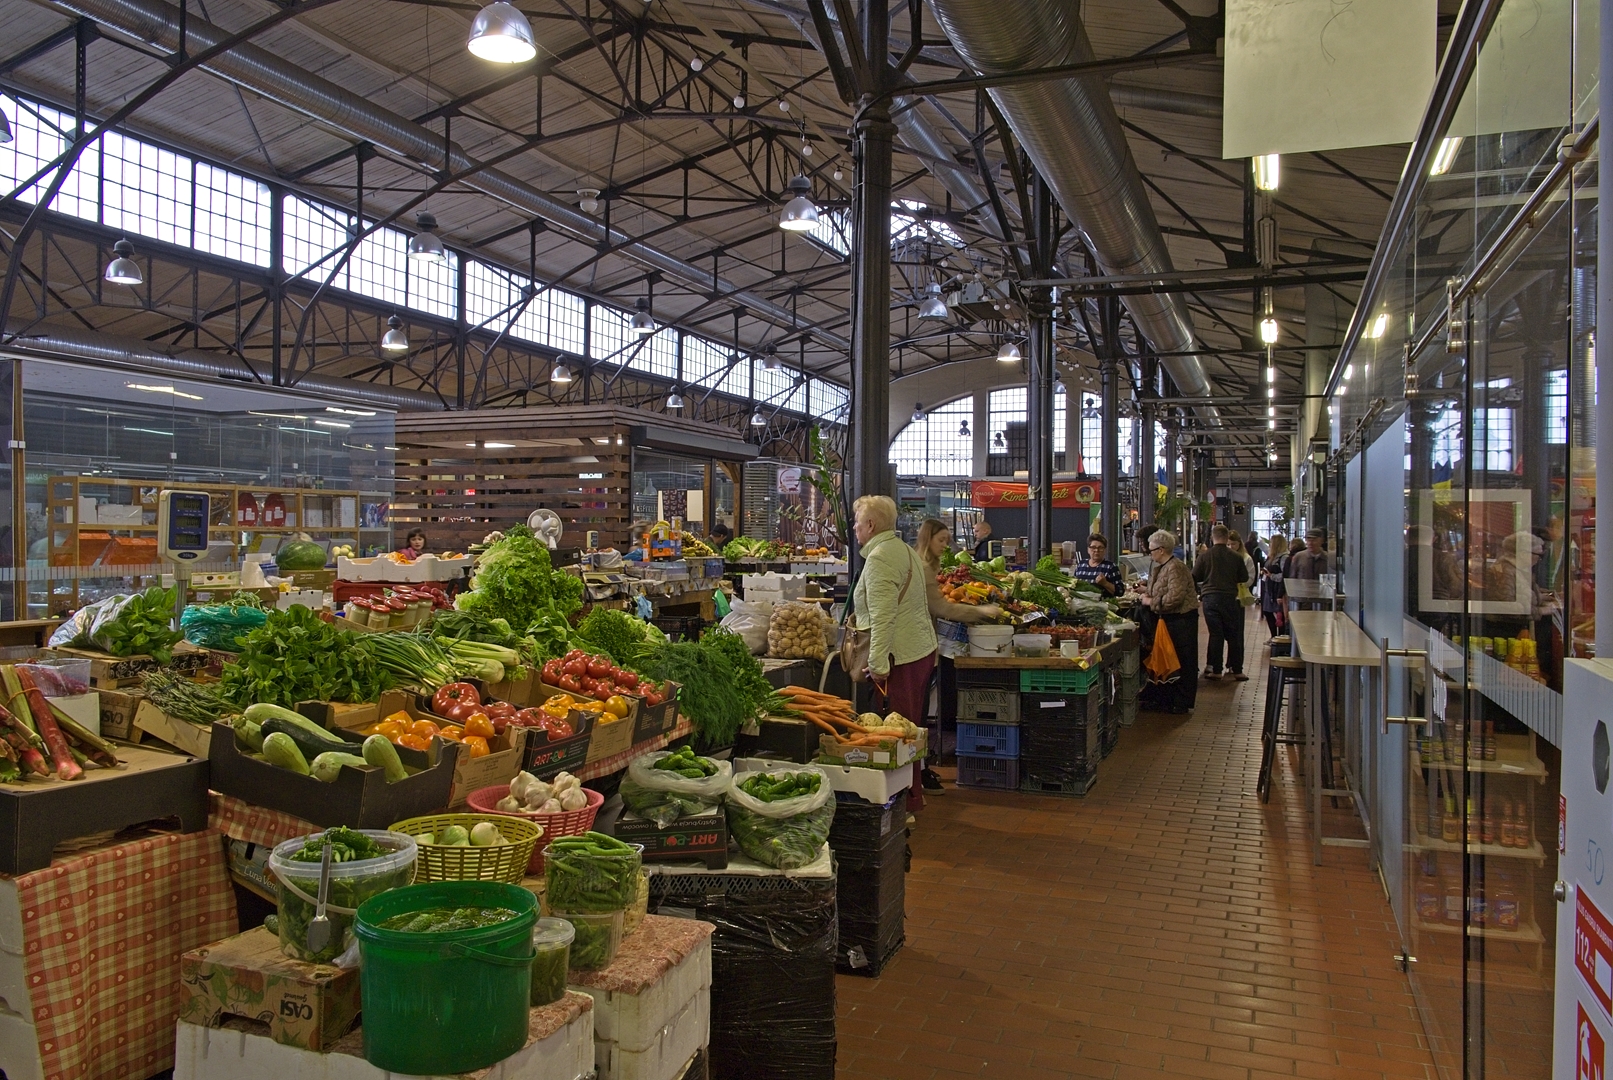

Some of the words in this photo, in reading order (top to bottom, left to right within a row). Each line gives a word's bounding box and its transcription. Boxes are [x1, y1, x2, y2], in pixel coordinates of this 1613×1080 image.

[26, 473, 48, 481] JIMAS
[1000, 490, 1029, 502] Kimc
[1052, 487, 1069, 499] telė
[1586, 838, 1605, 886] 50
[243, 866, 262, 883] Luna
[1576, 926, 1590, 969] 112
[280, 999, 314, 1020] CASI
